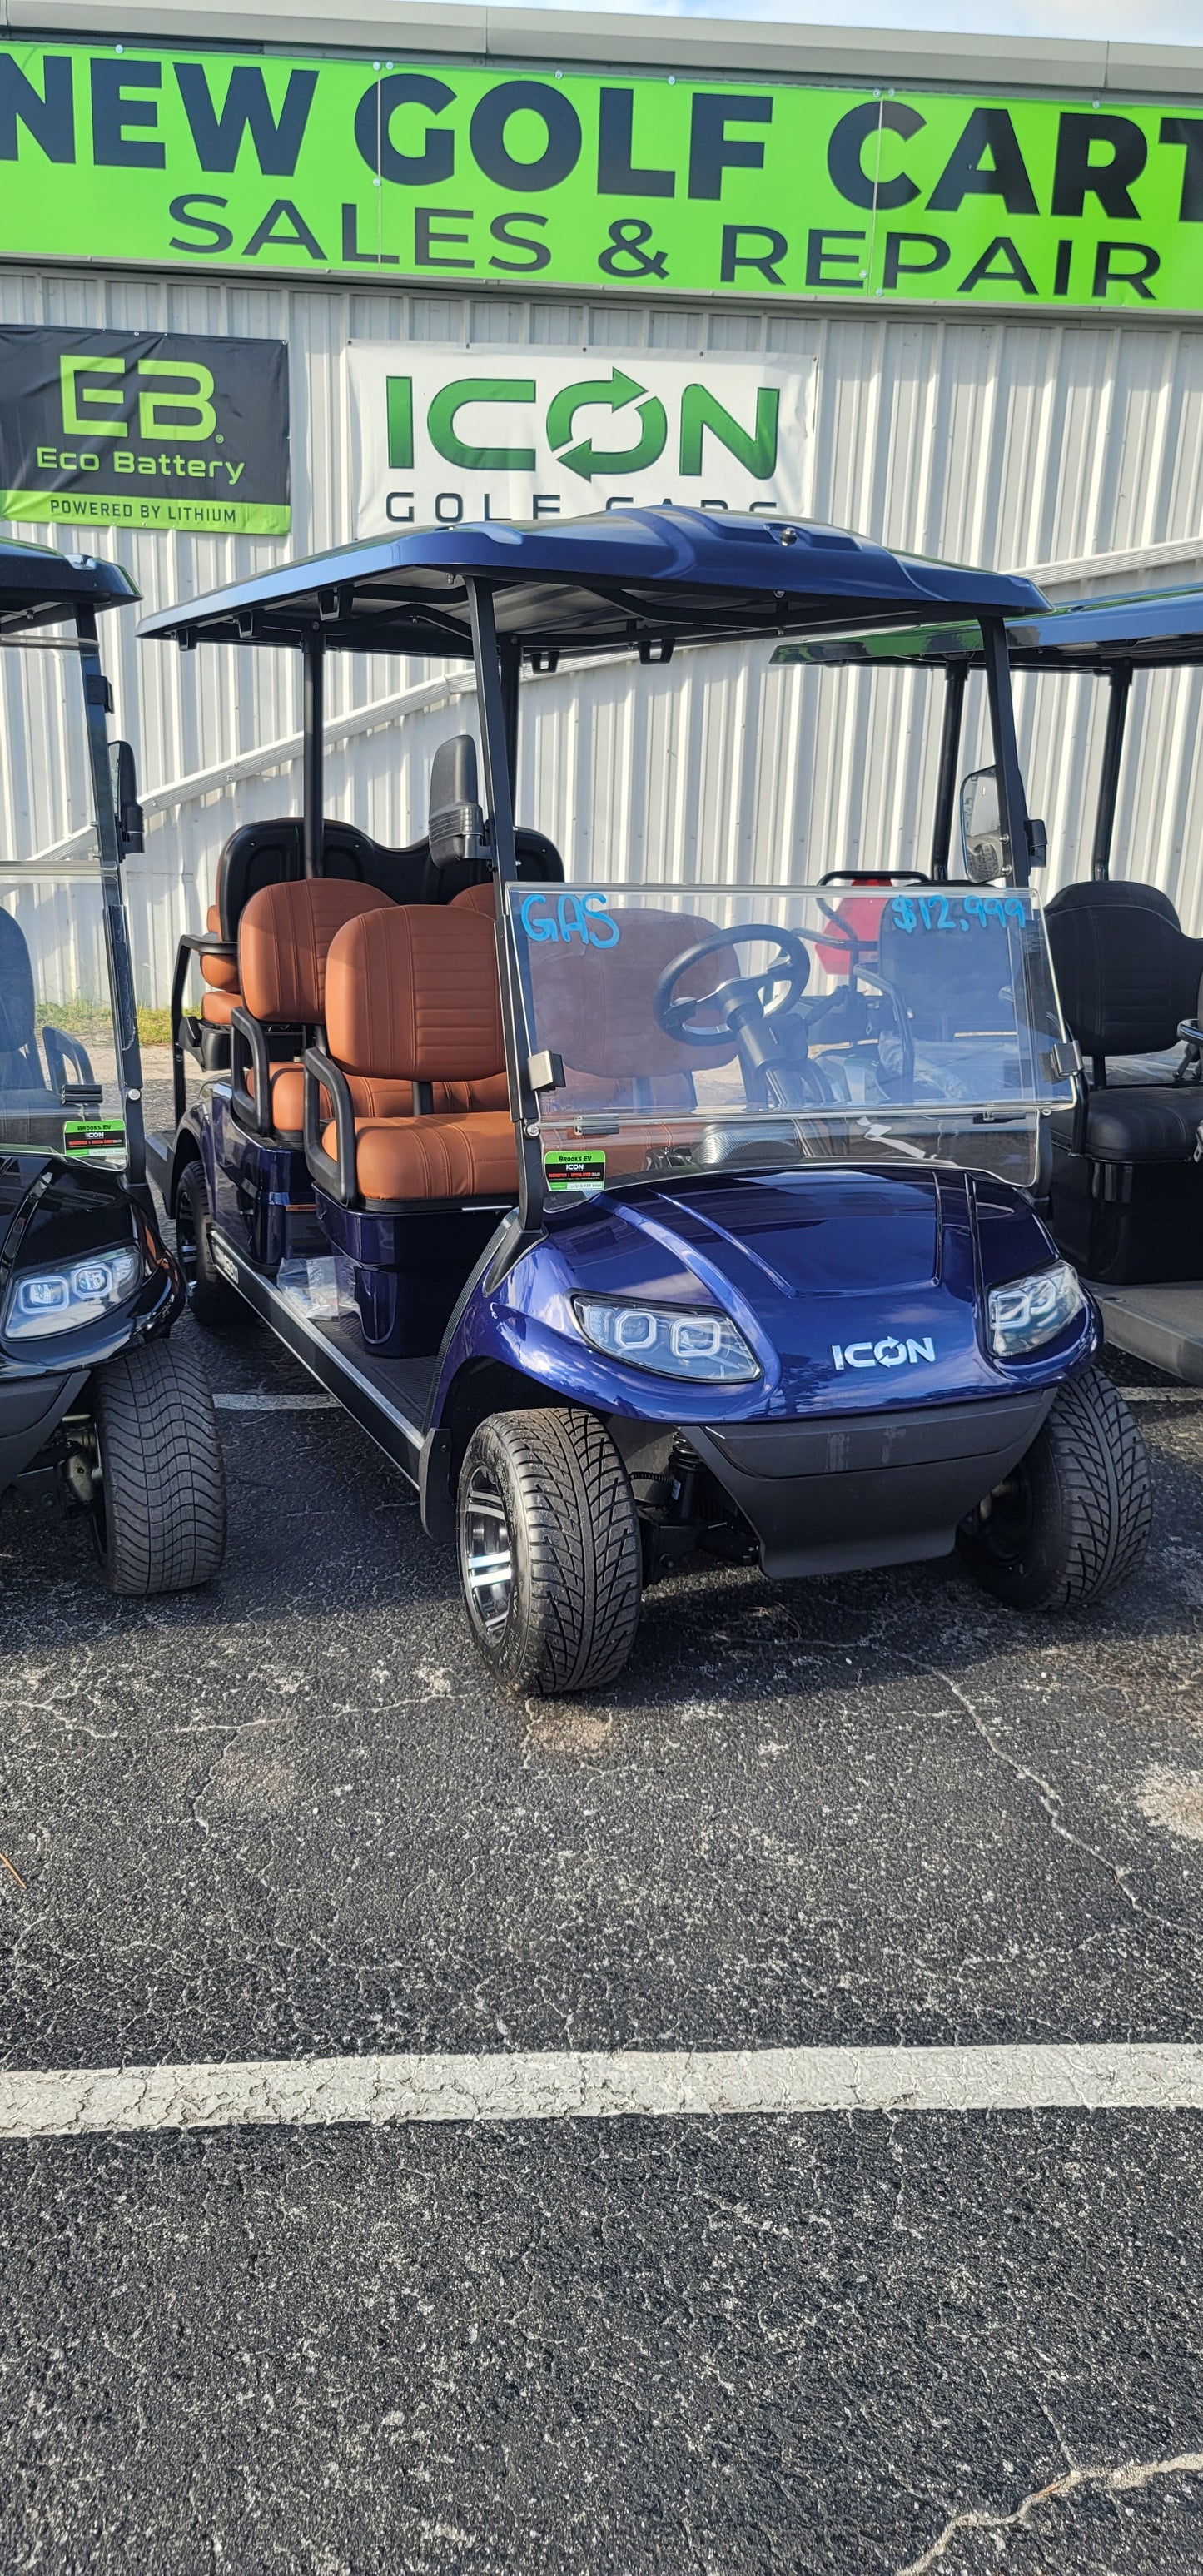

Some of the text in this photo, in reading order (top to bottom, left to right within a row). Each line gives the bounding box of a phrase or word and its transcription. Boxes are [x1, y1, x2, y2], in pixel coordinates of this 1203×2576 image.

[0, 52, 1203, 222] NEW GOLF CART
[169, 194, 1161, 301] SALES & REPAIR
[60, 355, 217, 442] EB
[385, 366, 781, 484] ICON
[37, 446, 246, 485] Eco Battery
[50, 500, 236, 524] POWERED BY LITHIUM
[385, 491, 561, 522] GOLF
[520, 892, 620, 949] GAS
[892, 893, 1026, 933] $12,999
[833, 1335, 936, 1371] ICON
